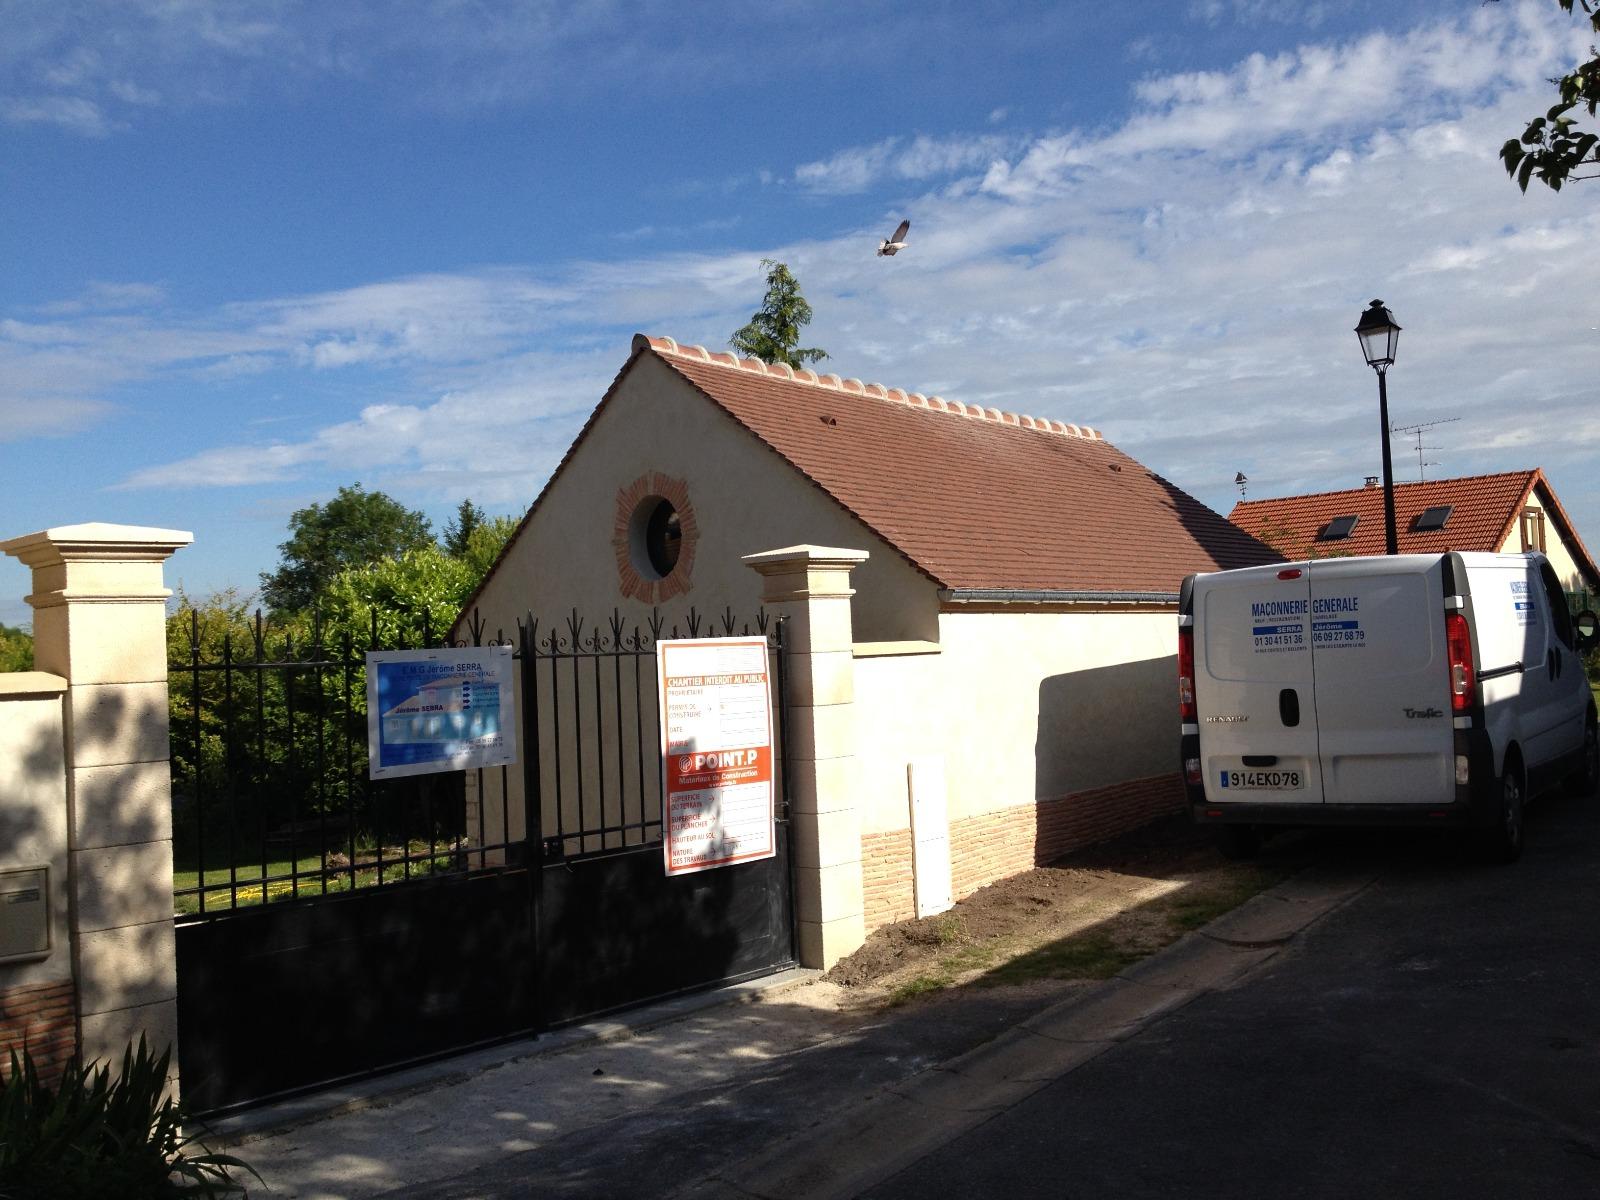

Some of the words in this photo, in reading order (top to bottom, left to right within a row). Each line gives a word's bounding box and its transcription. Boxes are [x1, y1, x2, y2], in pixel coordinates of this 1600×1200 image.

[1252, 600, 1308, 617] MAÇONNERIE
[1312, 597, 1359, 613] GENERALE
[1313, 623, 1343, 631] Jérôme
[1254, 637, 1264, 646] 01
[1265, 636, 1273, 646] 30
[1274, 635, 1282, 645] 41
[1284, 635, 1292, 644] 51
[1313, 632, 1322, 642] 06
[1323, 632, 1333, 641] 09
[1334, 631, 1343, 641] 27
[1355, 630, 1365, 640] 79
[456, 662, 482, 672] SERRA
[668, 677, 704, 687] CHANTIER
[705, 675, 733, 686] INTERDIT
[734, 675, 742, 684] AU
[743, 673, 765, 683] PUBLIC
[1402, 707, 1444, 719] Trafic
[695, 749, 758, 771] POINT.P
[721, 769, 758, 780] Construction
[671, 794, 700, 802] SUPERFICIE
[680, 802, 703, 810] TERRAIN
[671, 814, 701, 823] SUPERFICIE
[672, 824, 680, 832] DU
[680, 821, 708, 831] PLANCHER
[672, 836, 696, 845] HAUTEUR
[705, 832, 715, 840] SOL
[672, 849, 693, 857] NATURE
[673, 857, 683, 866] DES
